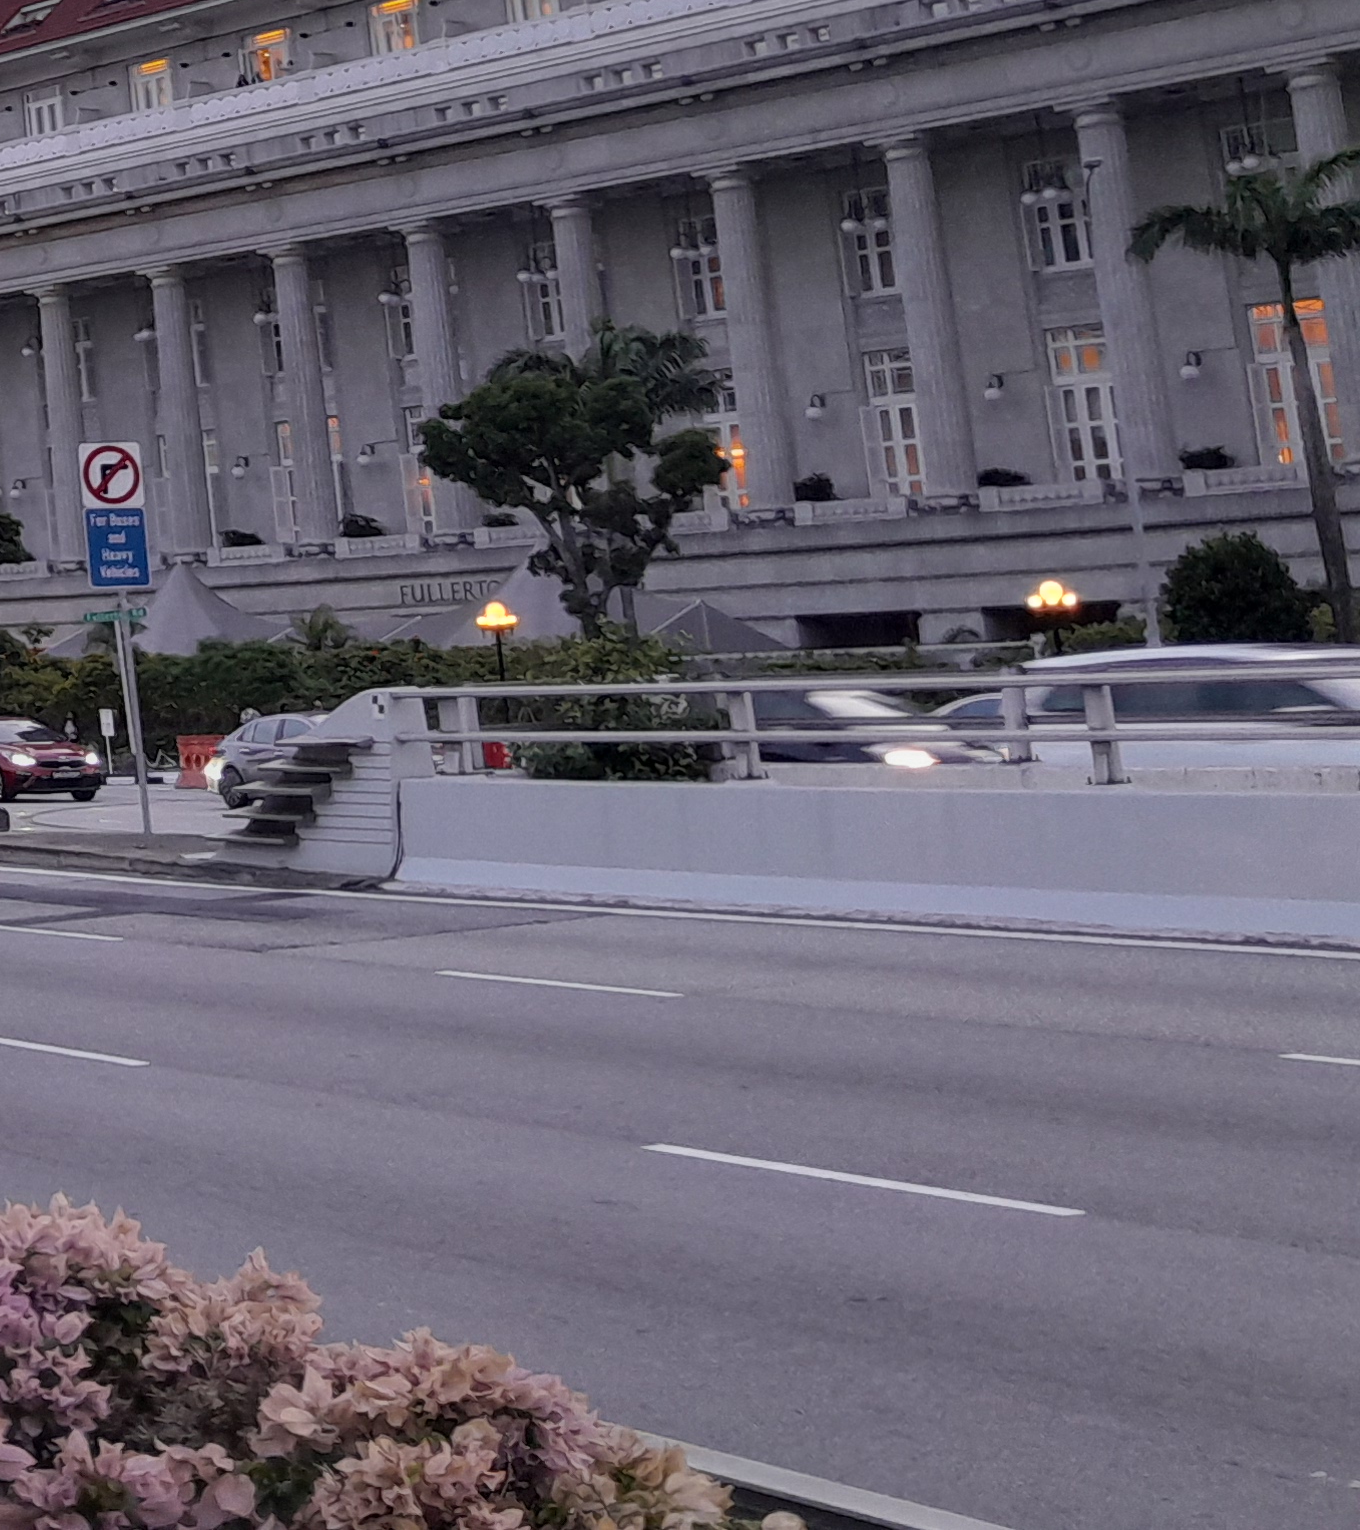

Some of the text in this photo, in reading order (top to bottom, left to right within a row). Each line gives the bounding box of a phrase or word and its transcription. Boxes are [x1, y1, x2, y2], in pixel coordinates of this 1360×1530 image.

[90, 513, 108, 527] For
[107, 530, 126, 544] and
[101, 547, 133, 564] Heavy
[400, 579, 502, 605] FULLERTO
